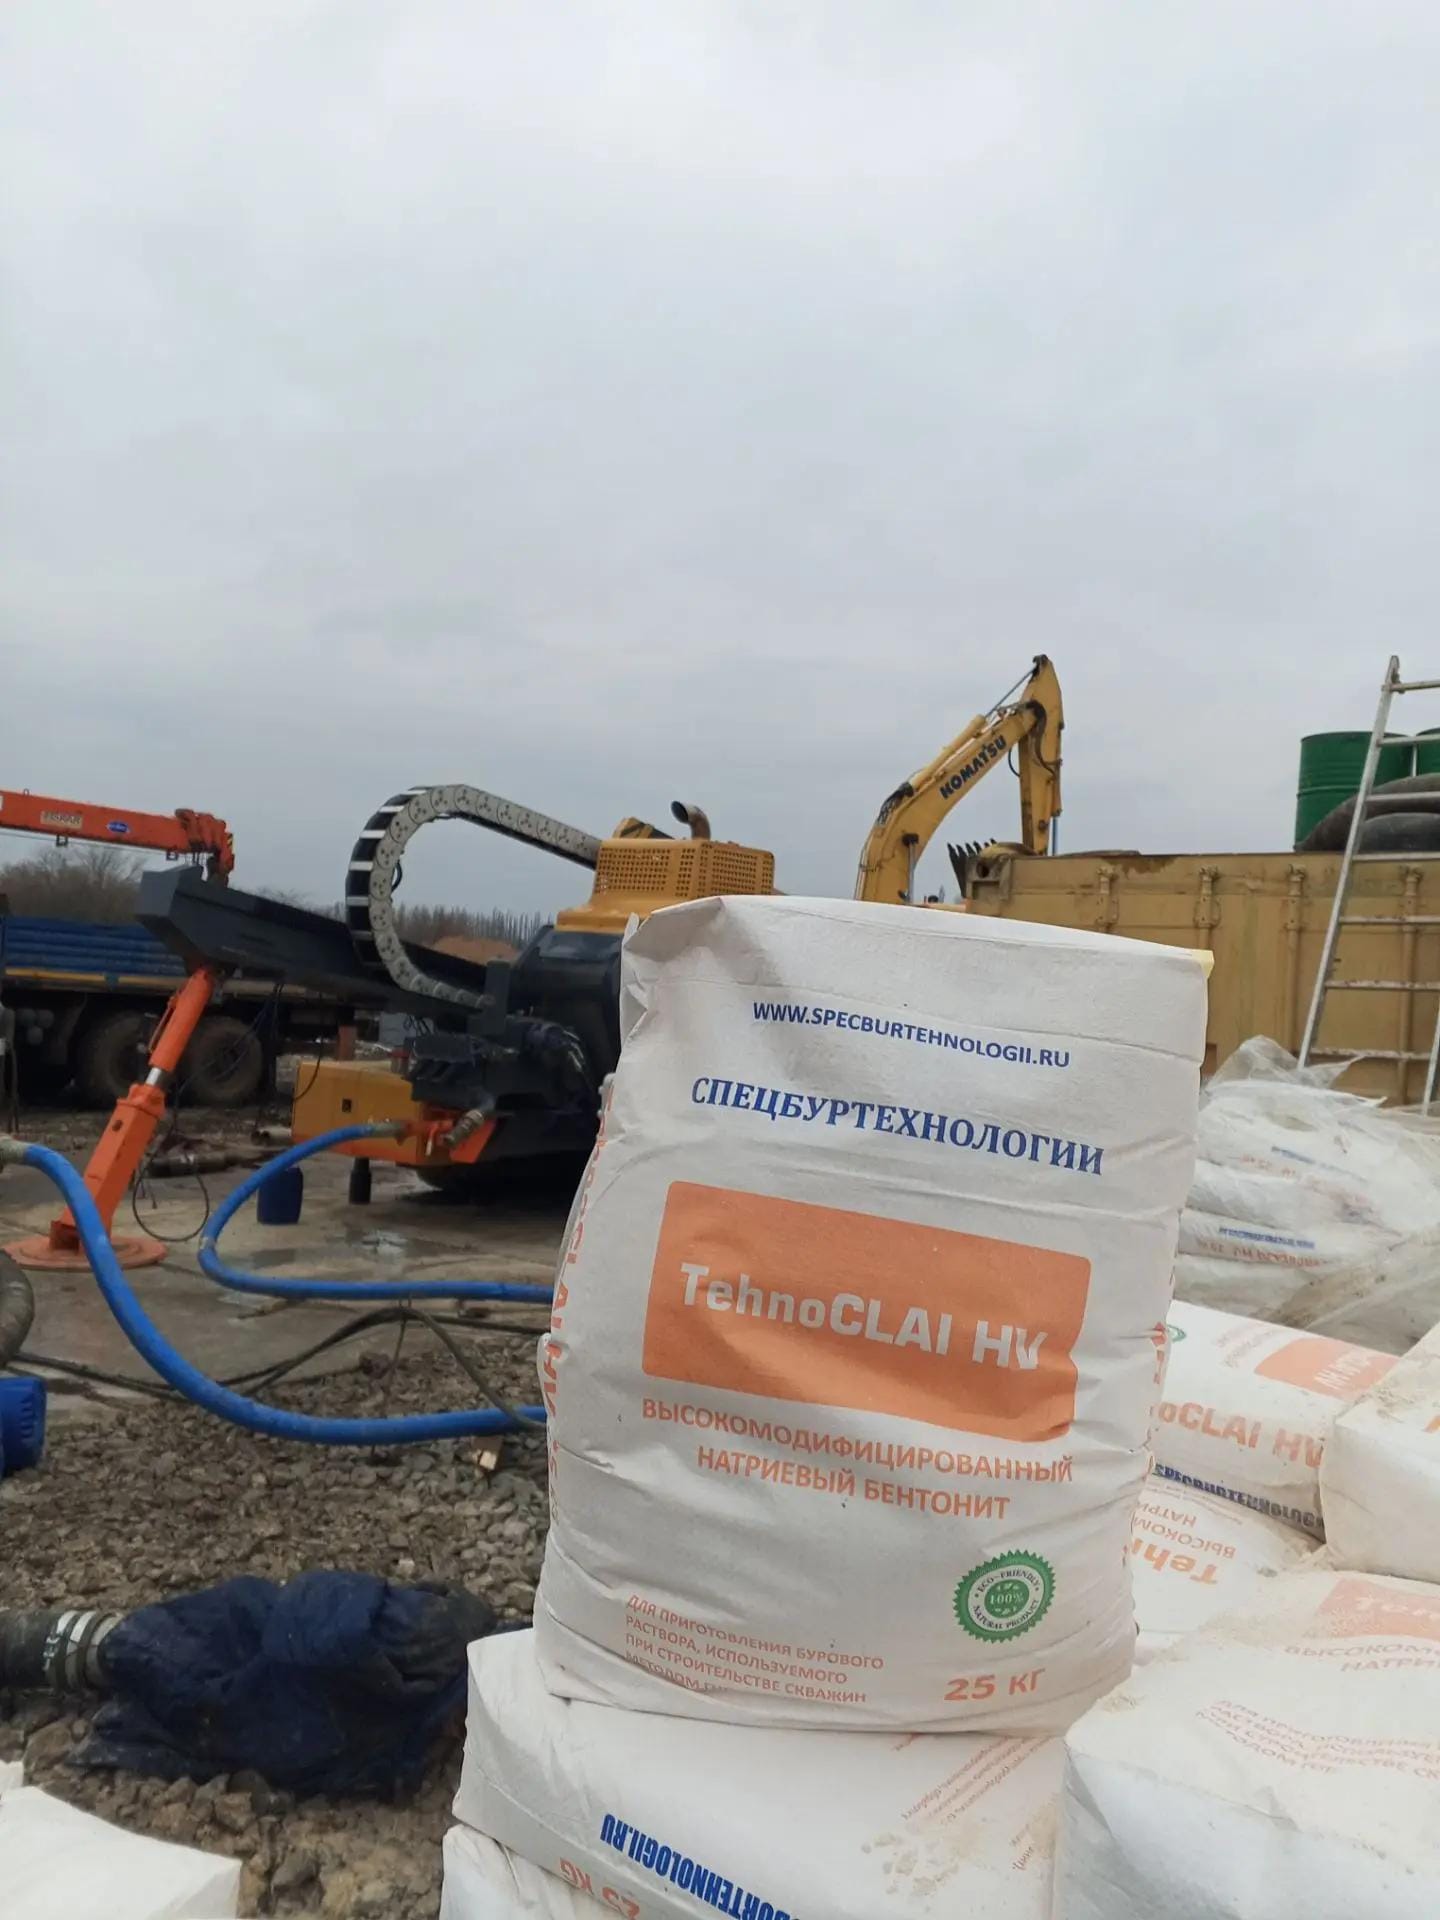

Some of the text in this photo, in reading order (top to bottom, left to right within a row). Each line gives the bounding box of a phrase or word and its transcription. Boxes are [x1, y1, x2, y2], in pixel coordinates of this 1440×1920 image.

[940, 734, 1006, 799] KOMATSU
[753, 1001, 1071, 1069] WWW.SPECBURTEHNOLOGII.RU
[690, 1076, 1105, 1176] СПЕЦБУРТЕХНОЛОГИИ
[680, 1262, 1048, 1371] TehnoCLAI HV
[641, 1397, 1074, 1484] ВЫСОКОМОДИФИЦИРОВАННЫЙ
[698, 1445, 1011, 1520] НАТРИЕВЫЙ БЕНТОНИТ
[624, 1614, 849, 1684] РАСТВОРА, ИСПОЛЬЗУЕМОГО
[625, 1594, 885, 1670] ДЛЯ ПРИГОТОВЛЕНИЯ БУРОВОГО
[625, 1632, 654, 1655] ПРИ
[656, 1647, 782, 1692] СТРОИТЕЛЬСТВЕ
[784, 1682, 867, 1703] СКВАЖИН
[943, 1667, 1047, 1701] 25 КГ
